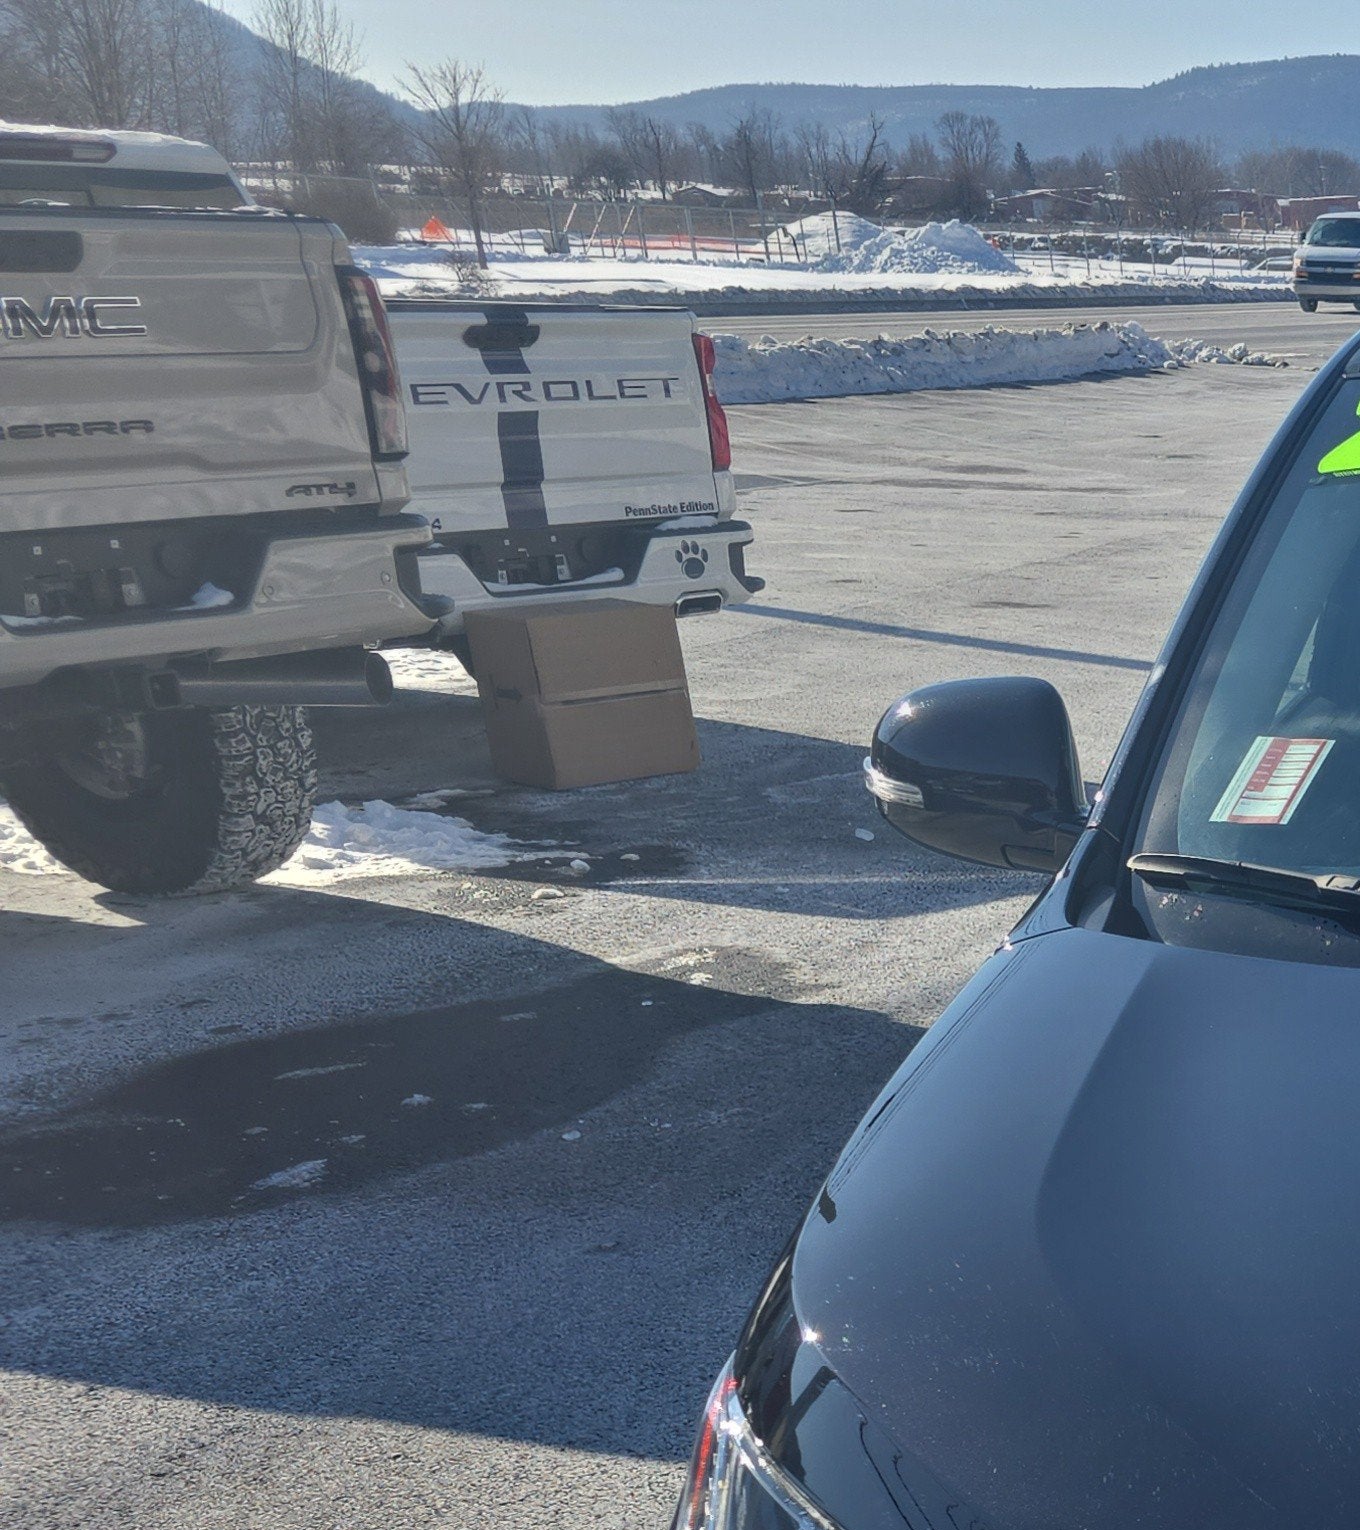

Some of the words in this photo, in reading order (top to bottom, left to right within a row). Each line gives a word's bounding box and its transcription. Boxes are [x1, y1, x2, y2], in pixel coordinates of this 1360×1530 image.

[0, 296, 148, 339] MC
[409, 377, 680, 405] EVROLET
[0, 419, 155, 440] ERRA
[624, 503, 679, 517] PennState
[679, 499, 715, 513] Edition
